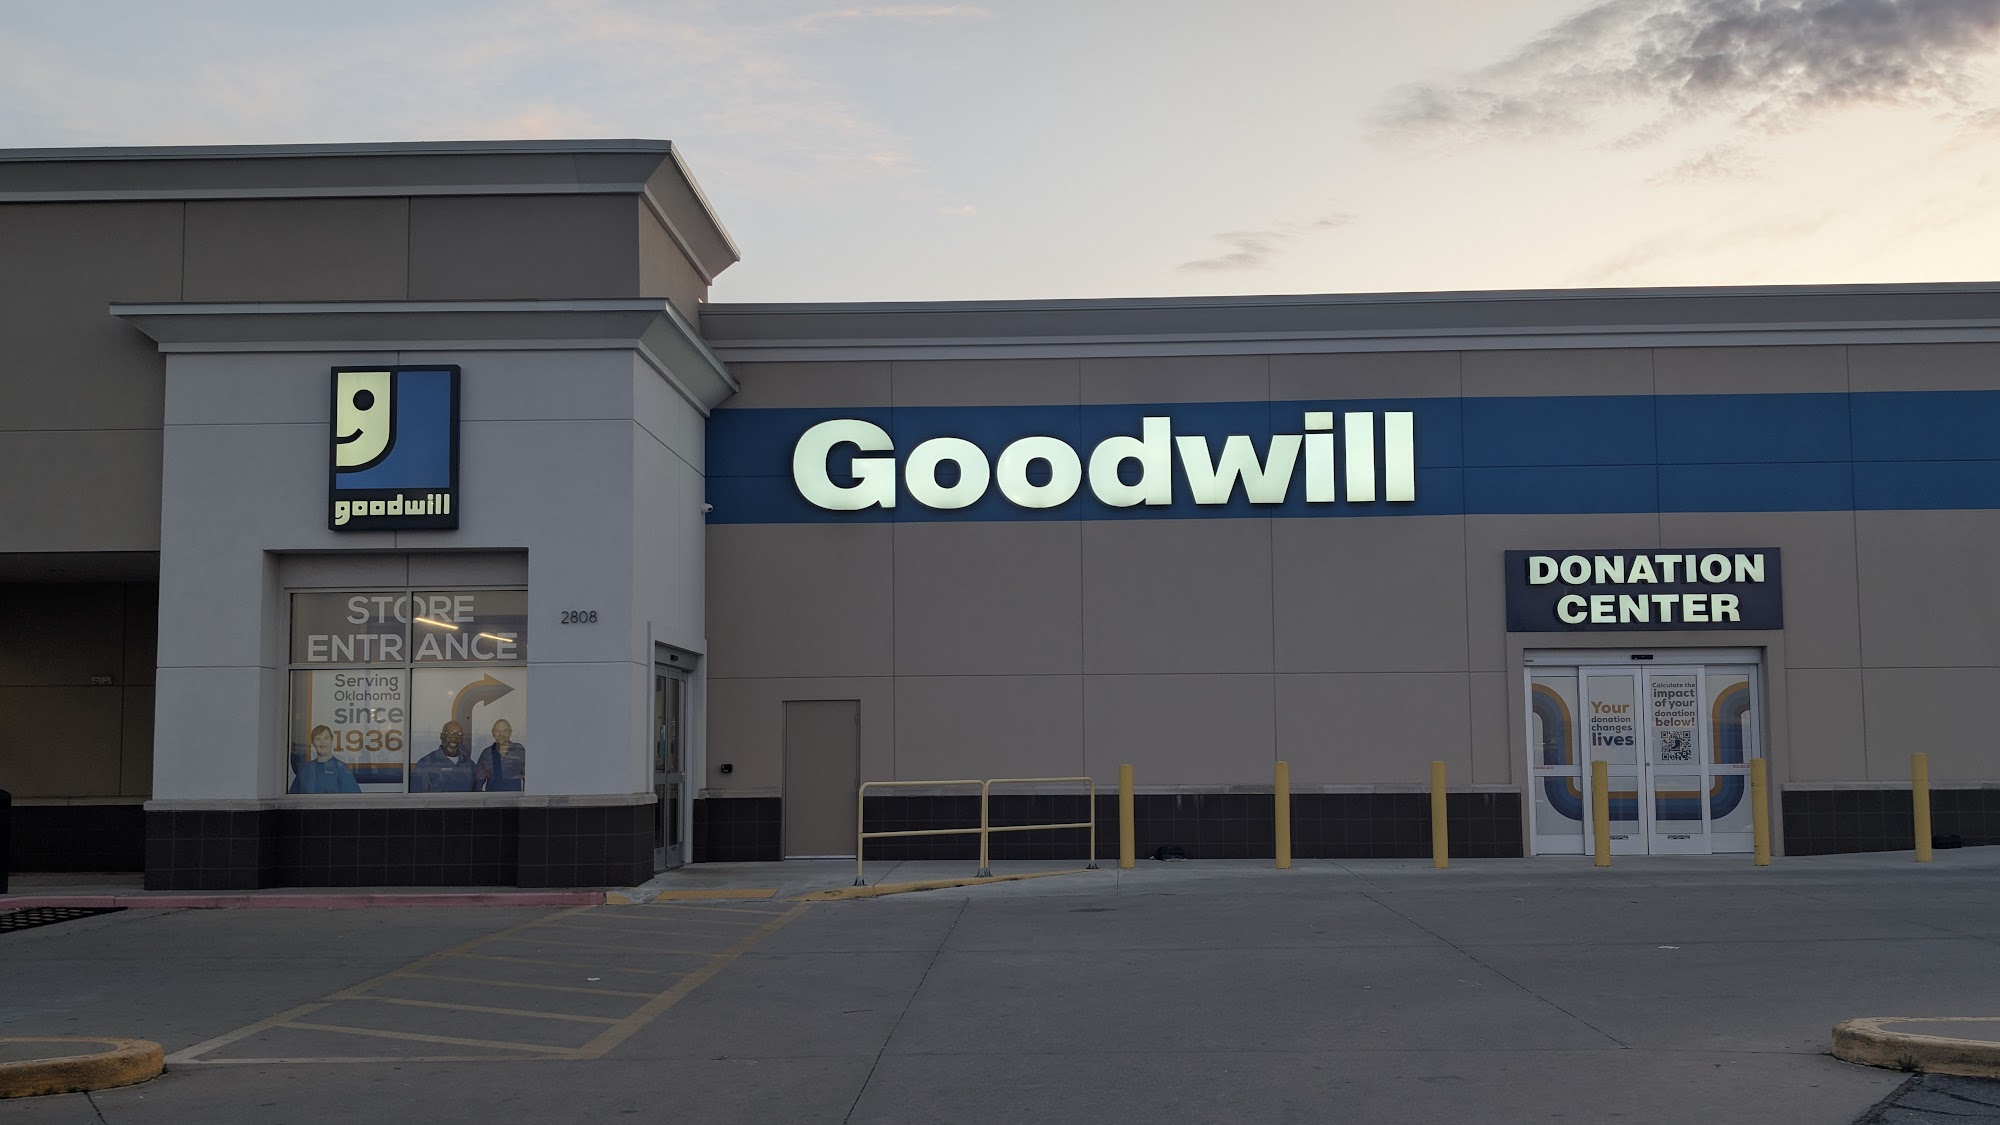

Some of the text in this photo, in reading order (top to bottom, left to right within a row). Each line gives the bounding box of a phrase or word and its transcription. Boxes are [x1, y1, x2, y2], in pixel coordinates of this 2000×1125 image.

[793, 411, 1415, 511] Goodwill
[335, 493, 450, 526] goodwill
[1529, 553, 1765, 585] DONATION
[347, 595, 475, 625] STORE
[1557, 593, 1741, 624] CENTER
[561, 610, 597, 624] 2808
[307, 632, 518, 662] ENTRANCE
[334, 673, 399, 692] Serving
[334, 690, 401, 702] Oklahoma
[1653, 688, 1695, 699] impact
[1590, 701, 1630, 714] Your
[1654, 699, 1695, 709] of your
[334, 702, 404, 724] since
[1654, 709, 1696, 717] donation
[1591, 723, 1633, 733] changes
[1655, 717, 1696, 727] below!
[333, 729, 403, 752] 1936
[1592, 732, 1634, 746] lives
